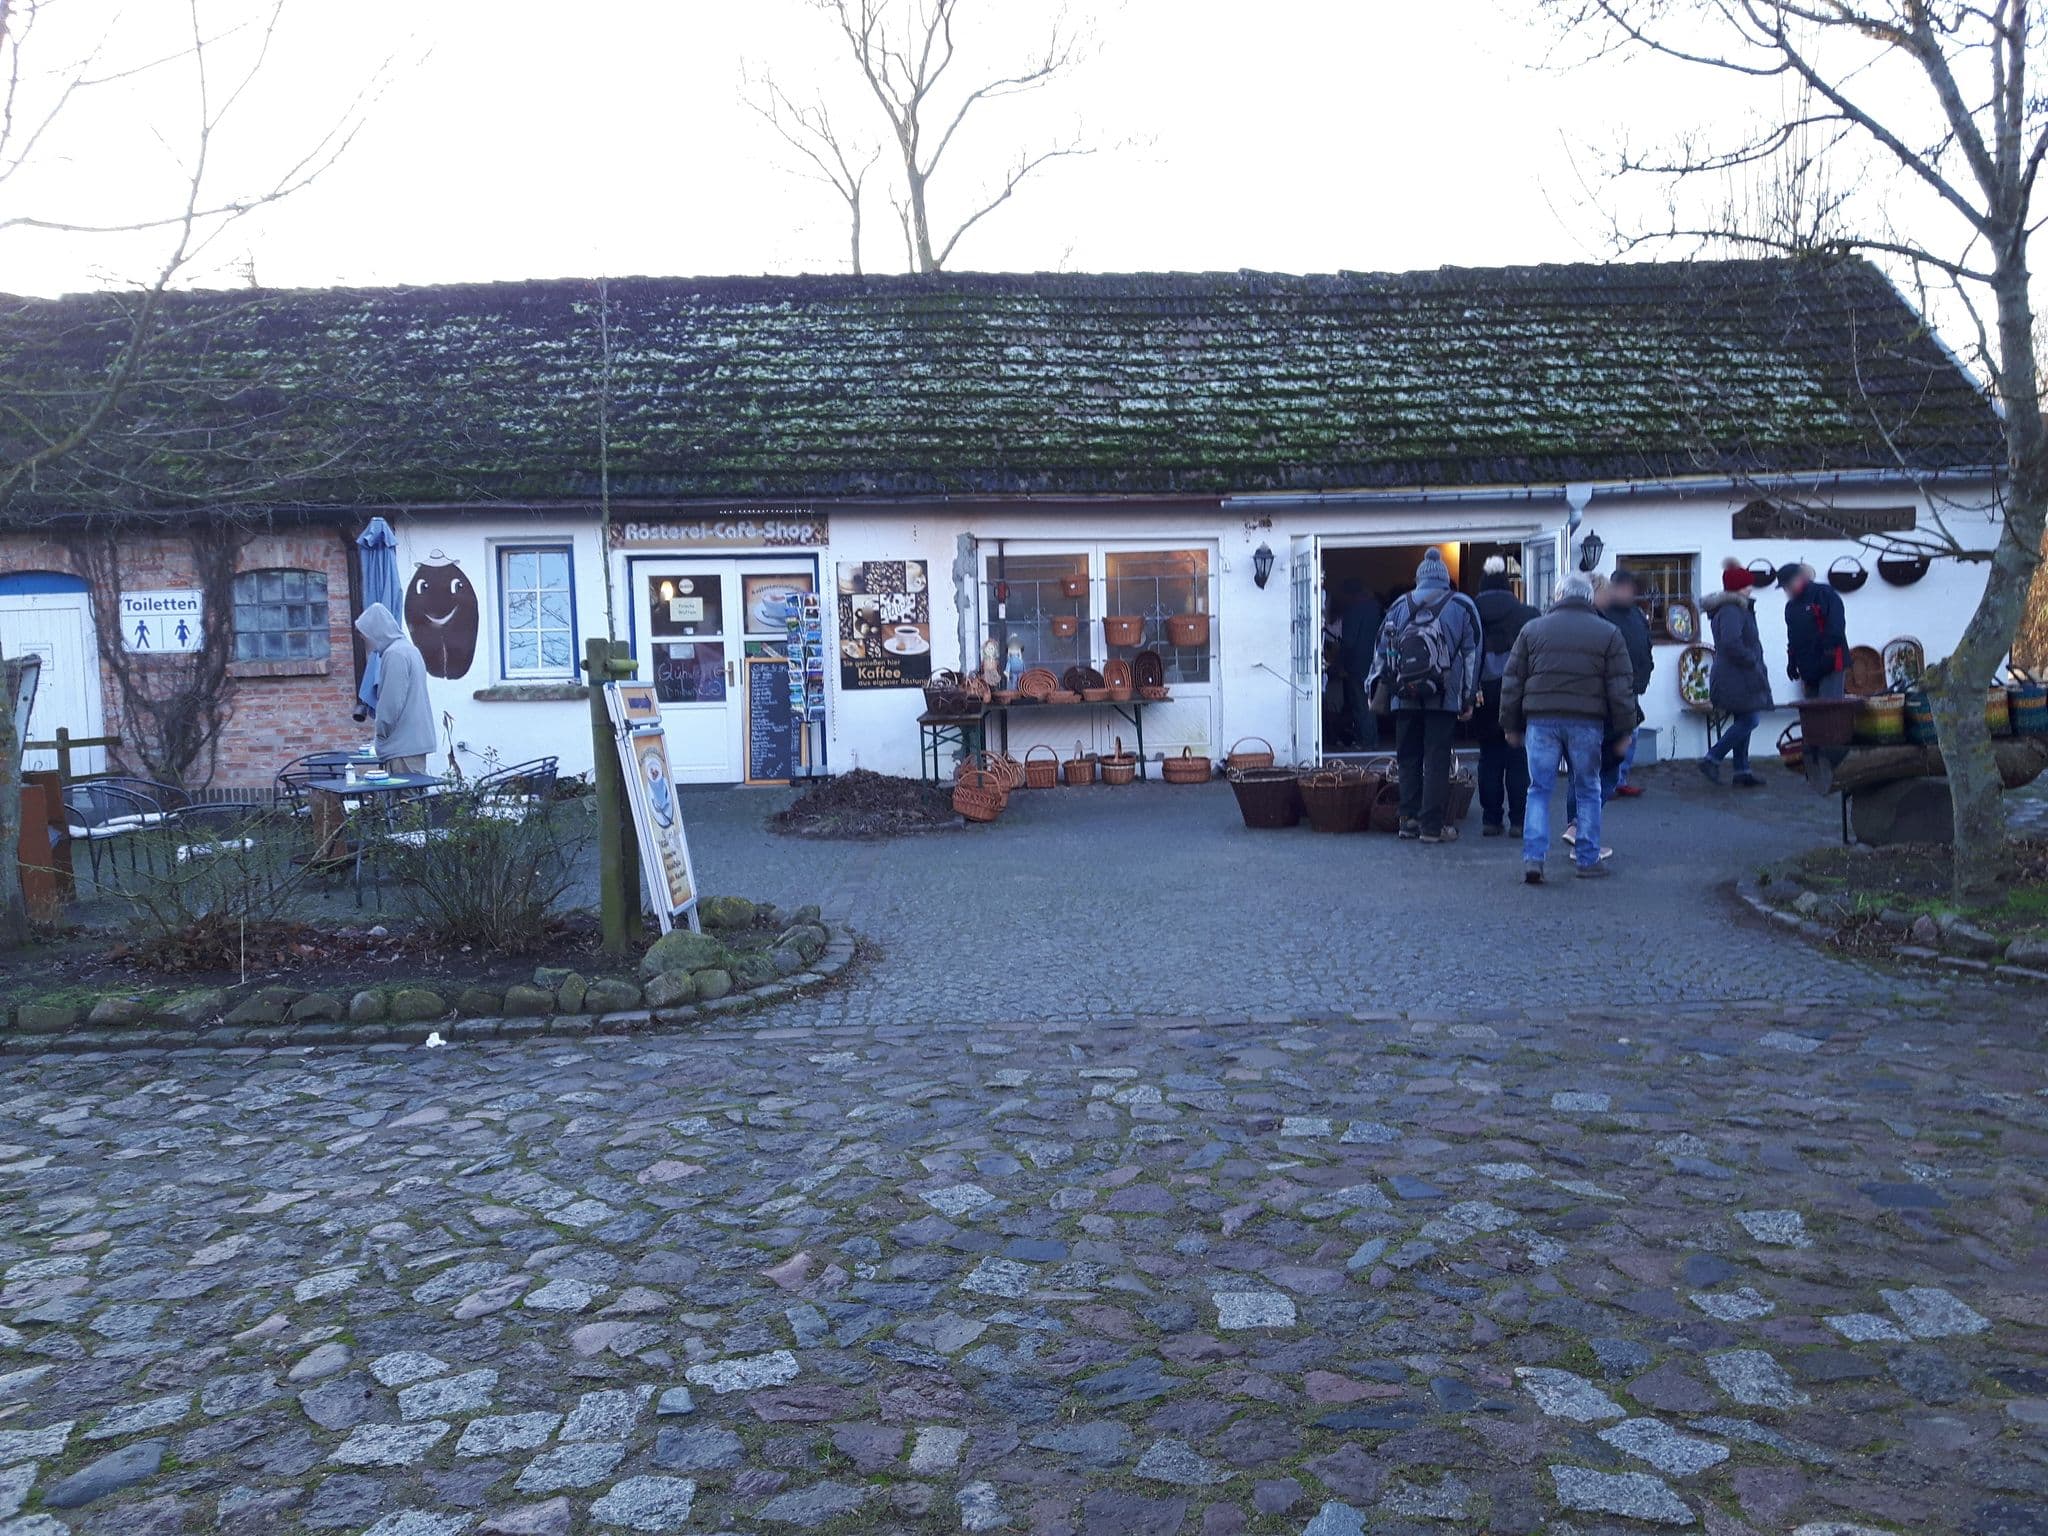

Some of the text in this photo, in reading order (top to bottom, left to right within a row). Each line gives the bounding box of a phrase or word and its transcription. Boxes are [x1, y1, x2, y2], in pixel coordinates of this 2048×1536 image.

[124, 598, 197, 611] Toiletten
[855, 660, 886, 668] genießen
[888, 659, 900, 667] hier
[858, 667, 901, 679] Kaffee
[900, 677, 928, 687] Röstung
